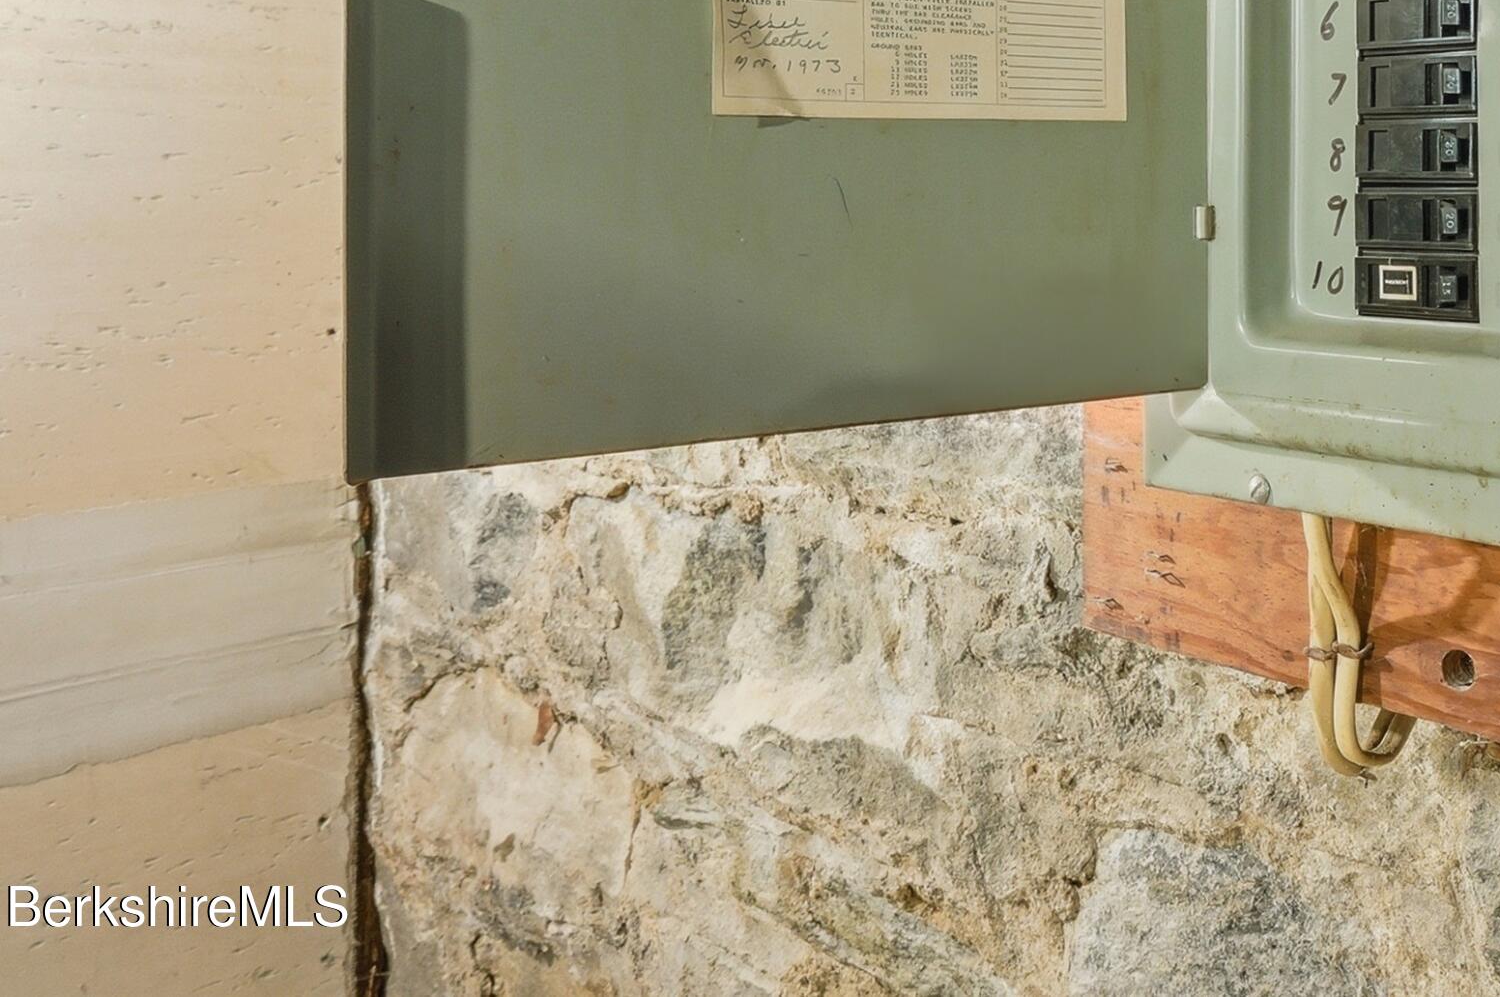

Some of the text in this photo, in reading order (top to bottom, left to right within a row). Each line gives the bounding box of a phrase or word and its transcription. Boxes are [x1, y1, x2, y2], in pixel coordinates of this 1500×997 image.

[1320, 1, 1340, 42] 6
[787, 59, 841, 75] 1973
[1328, 73, 1348, 106] 7
[1329, 137, 1346, 172] 8
[1327, 195, 1348, 238] 9
[1312, 260, 1345, 295] 10
